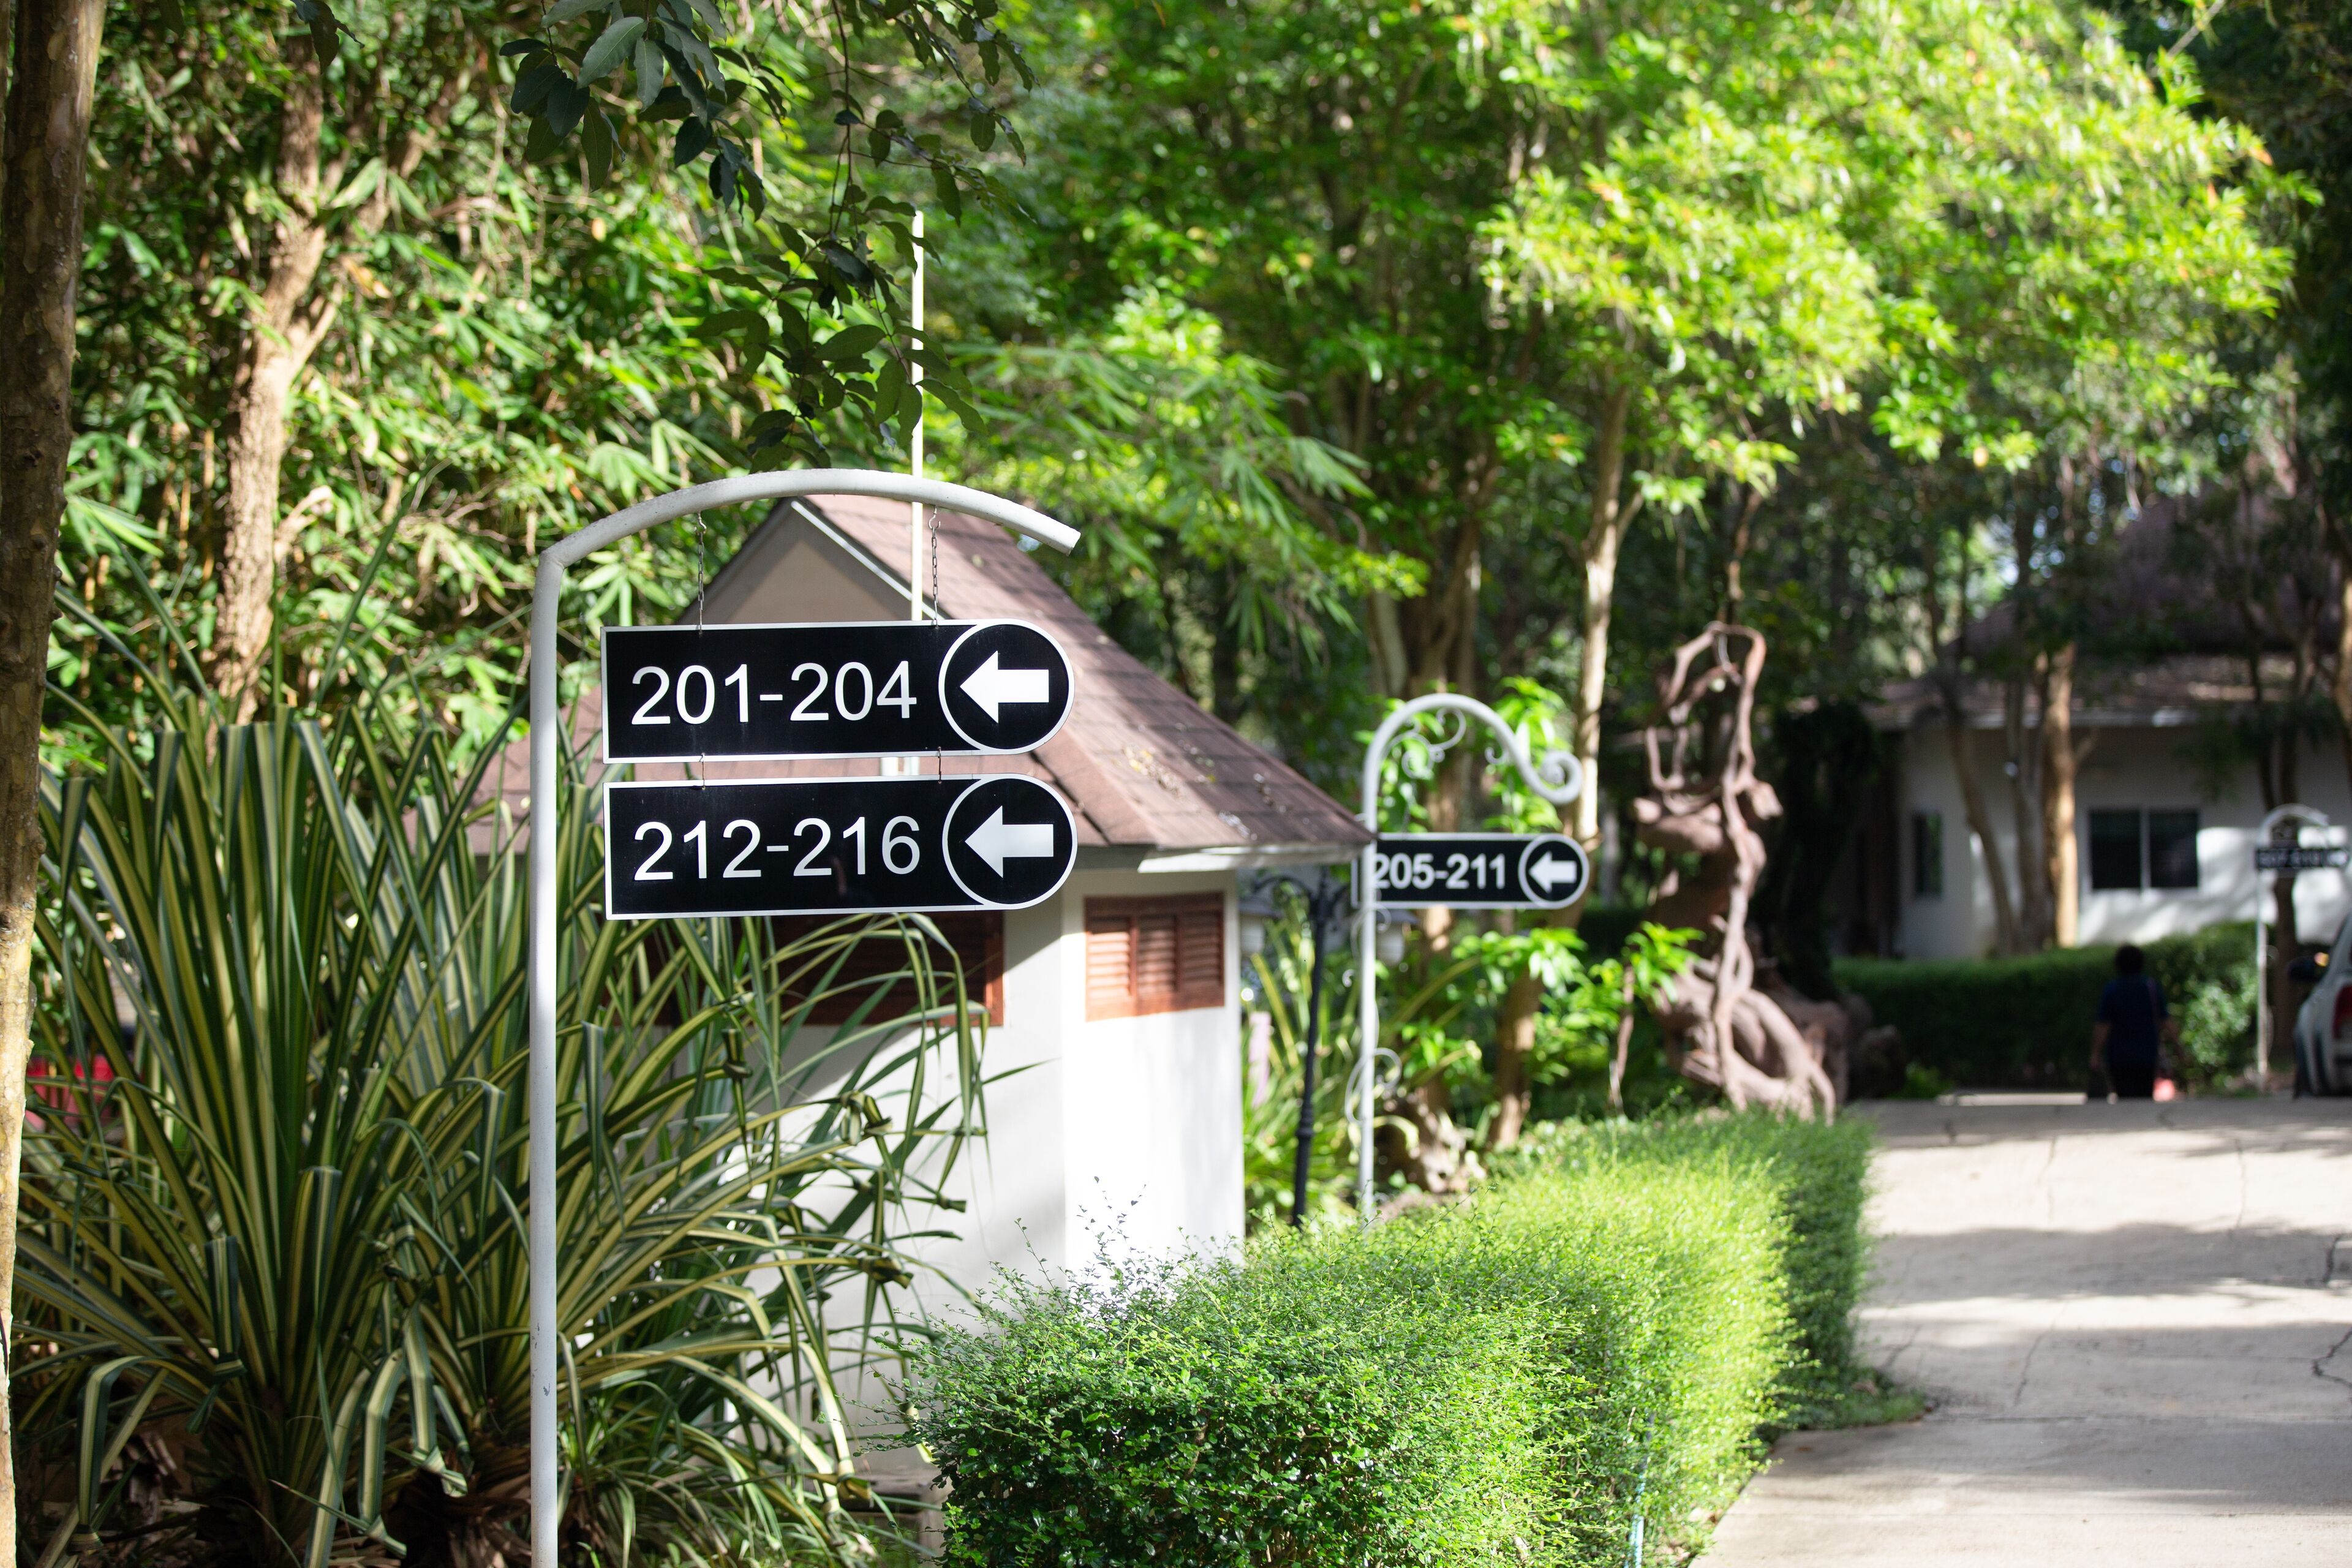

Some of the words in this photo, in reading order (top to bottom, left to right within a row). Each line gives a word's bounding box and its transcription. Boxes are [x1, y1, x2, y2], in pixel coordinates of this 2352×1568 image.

[631, 661, 916, 725] 201-204
[634, 816, 920, 881] 212-216
[1375, 853, 1506, 889] 205-211
